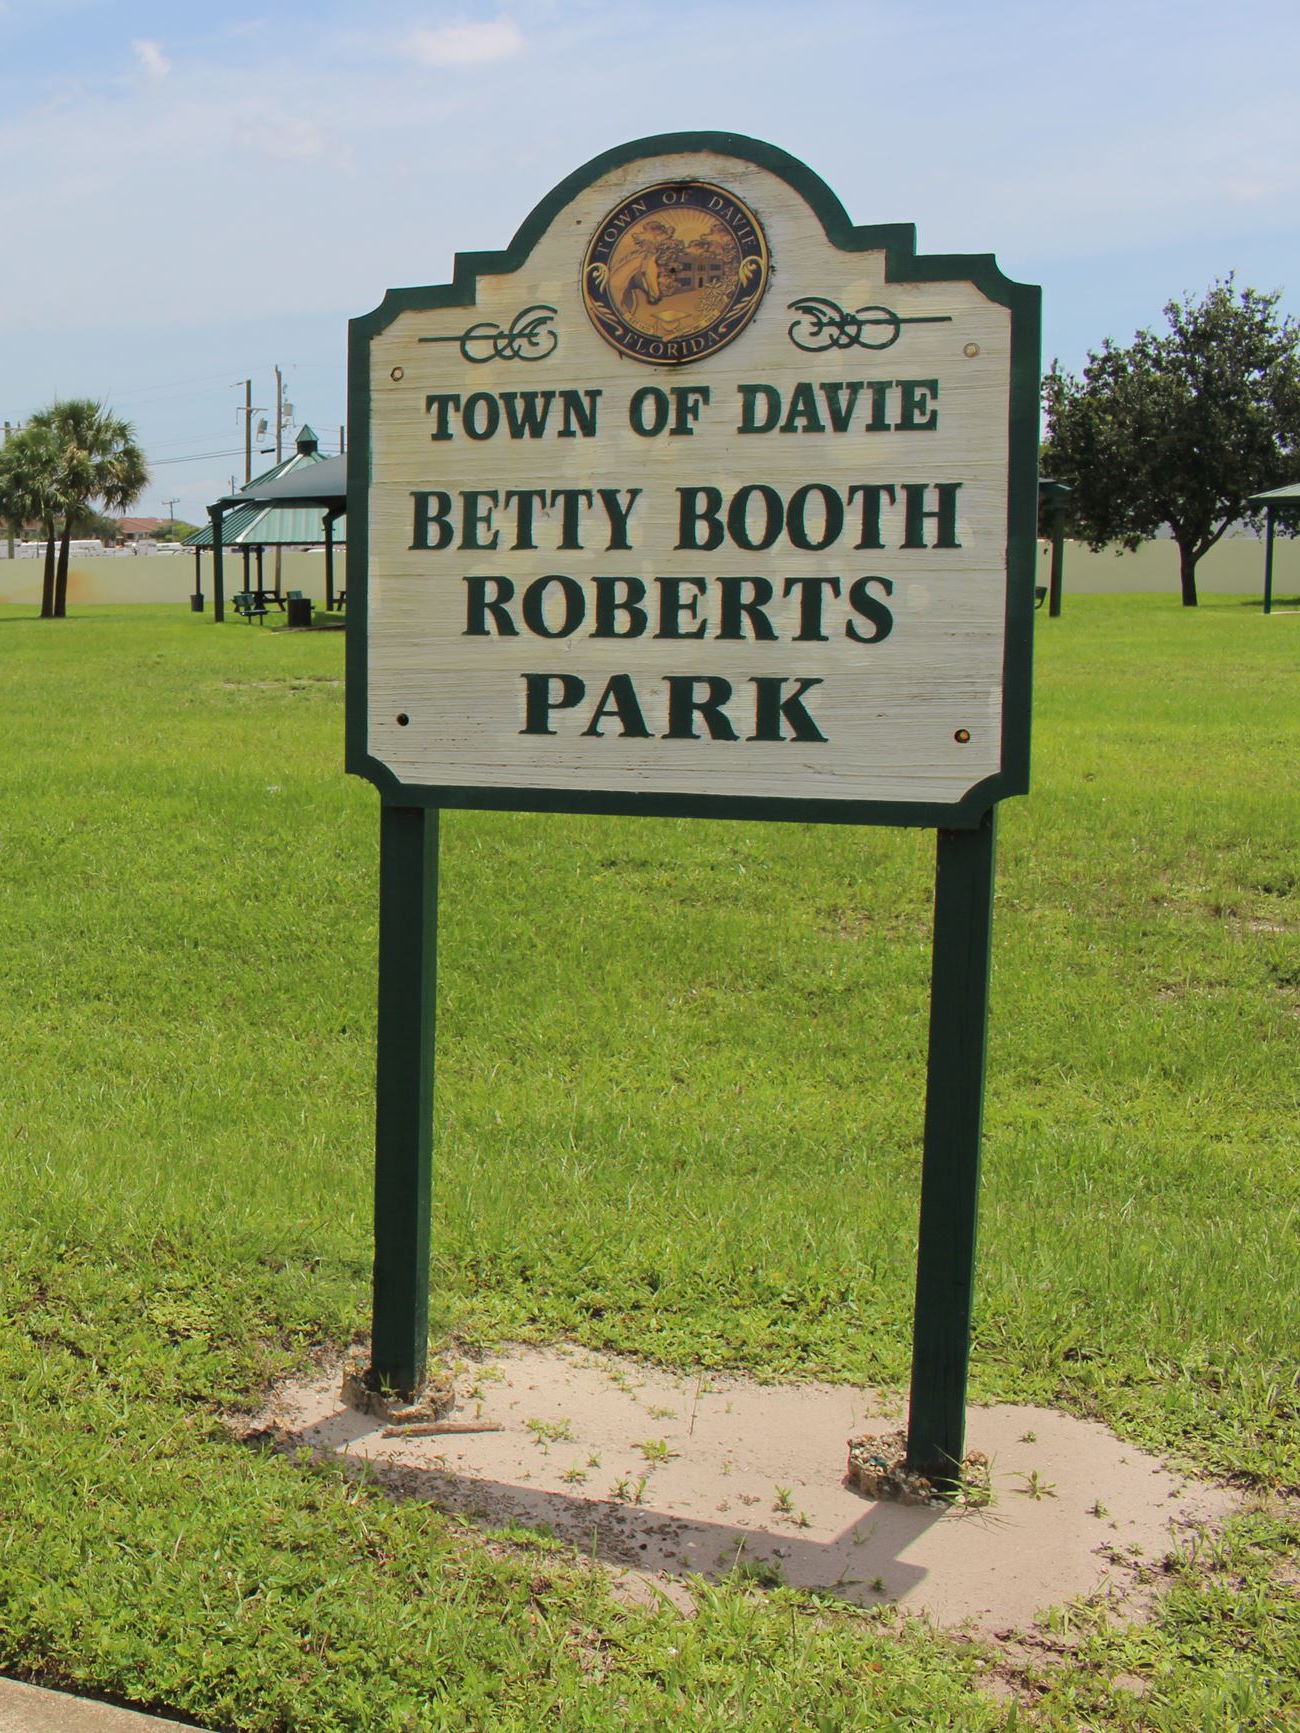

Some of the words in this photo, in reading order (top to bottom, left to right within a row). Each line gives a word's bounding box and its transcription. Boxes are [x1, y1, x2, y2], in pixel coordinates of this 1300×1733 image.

[595, 200, 649, 255] TOWN
[662, 189, 693, 204] OF
[708, 195, 757, 250] DAVIE
[622, 329, 722, 357] FLORIDA
[425, 388, 604, 442] TOWN
[628, 385, 711, 438] OF
[736, 378, 939, 435] DAVIE
[407, 487, 644, 553] BETTY
[672, 481, 964, 552] BOOTH
[460, 574, 895, 645] ROBERTS
[517, 672, 830, 744] PARK
